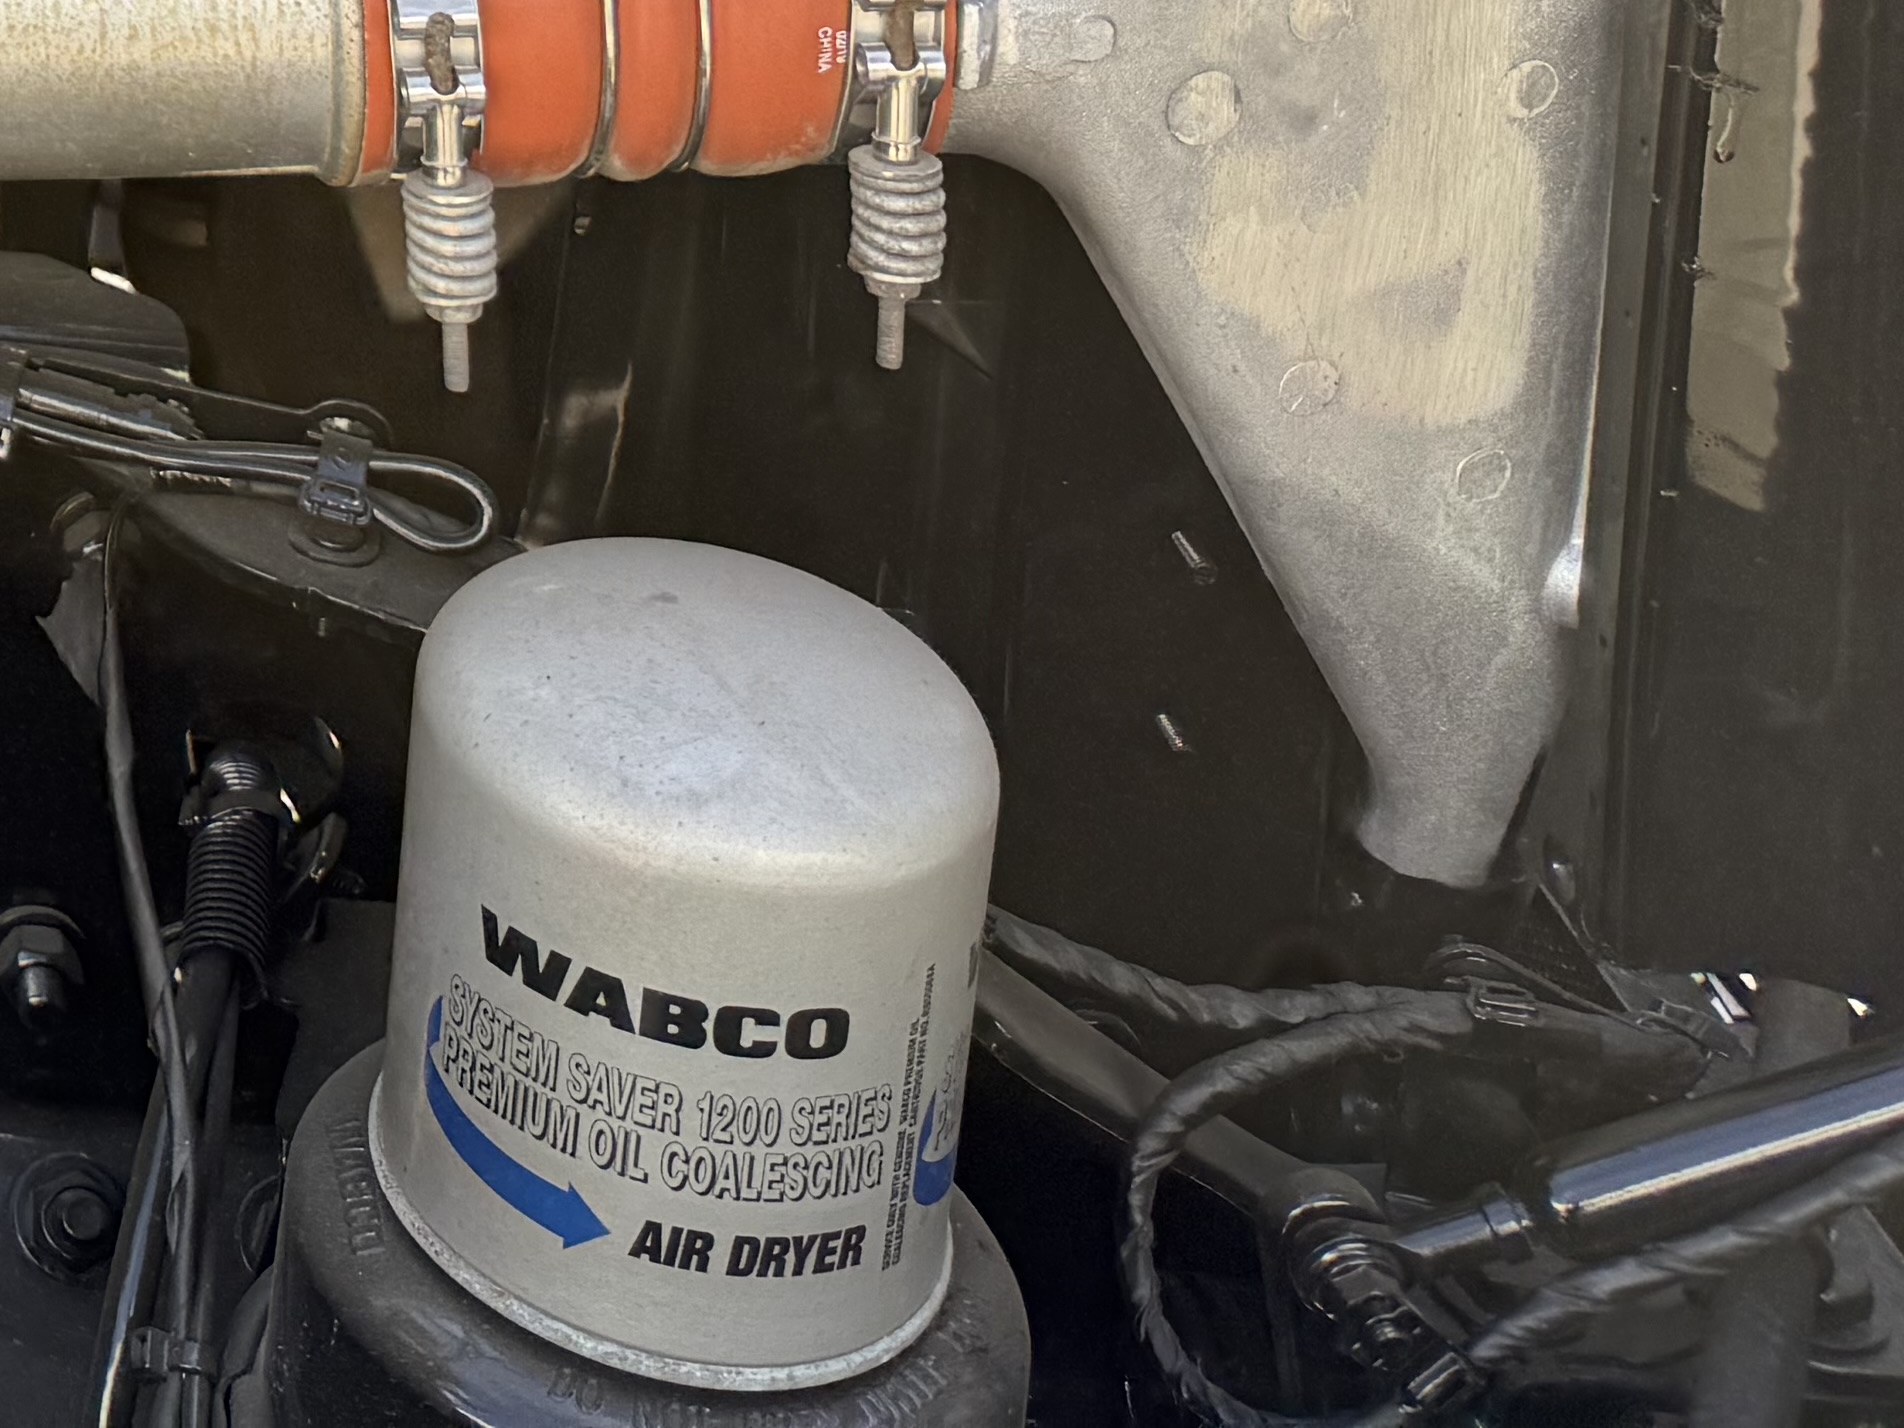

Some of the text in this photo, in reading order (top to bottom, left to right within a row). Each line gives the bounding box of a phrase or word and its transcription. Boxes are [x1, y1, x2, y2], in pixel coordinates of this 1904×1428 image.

[817, 26, 833, 74] CHINA
[480, 904, 851, 1061] WABCO
[441, 1022, 884, 1203] PREMIUM OIL COALESCING
[449, 974, 560, 1093] SYSTEM
[566, 1052, 684, 1136] SAVER
[696, 1090, 783, 1147] 1200
[789, 1083, 893, 1146] SERIES
[326, 1118, 386, 1256] WABCO
[627, 1219, 868, 1279] AIR DRYER
